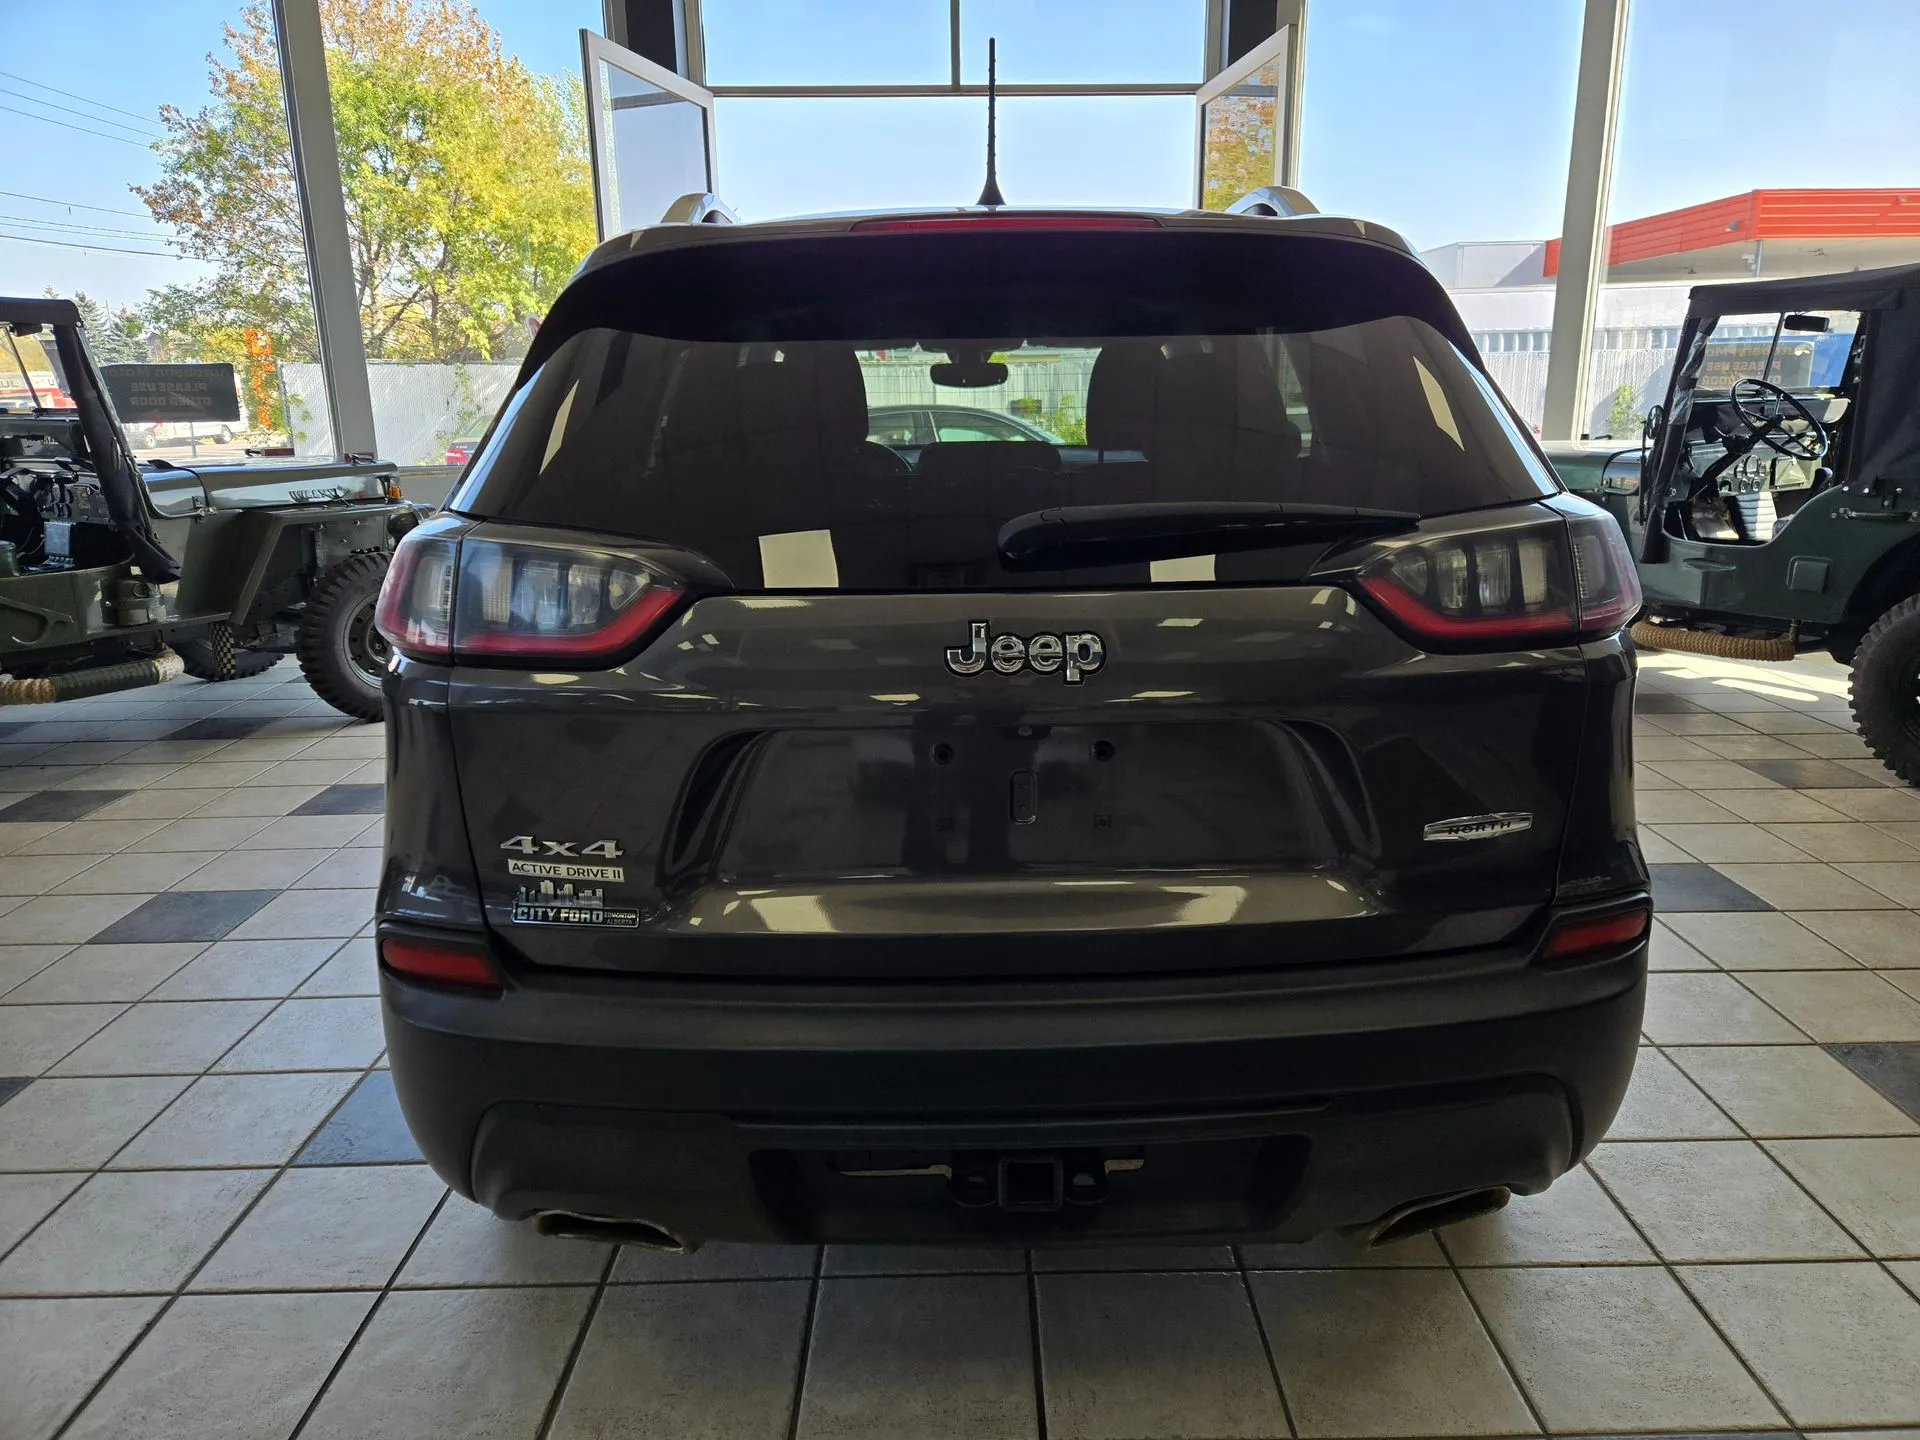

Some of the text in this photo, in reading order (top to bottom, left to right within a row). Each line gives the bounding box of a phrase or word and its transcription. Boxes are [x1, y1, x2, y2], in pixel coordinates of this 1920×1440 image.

[946, 621, 1104, 683] Jeep
[1447, 820, 1512, 835] NORTH
[500, 834, 624, 859] 4x4
[511, 862, 621, 879] ACTIVE DRIVE II
[516, 906, 636, 923] CITY FORD EDMONTON
